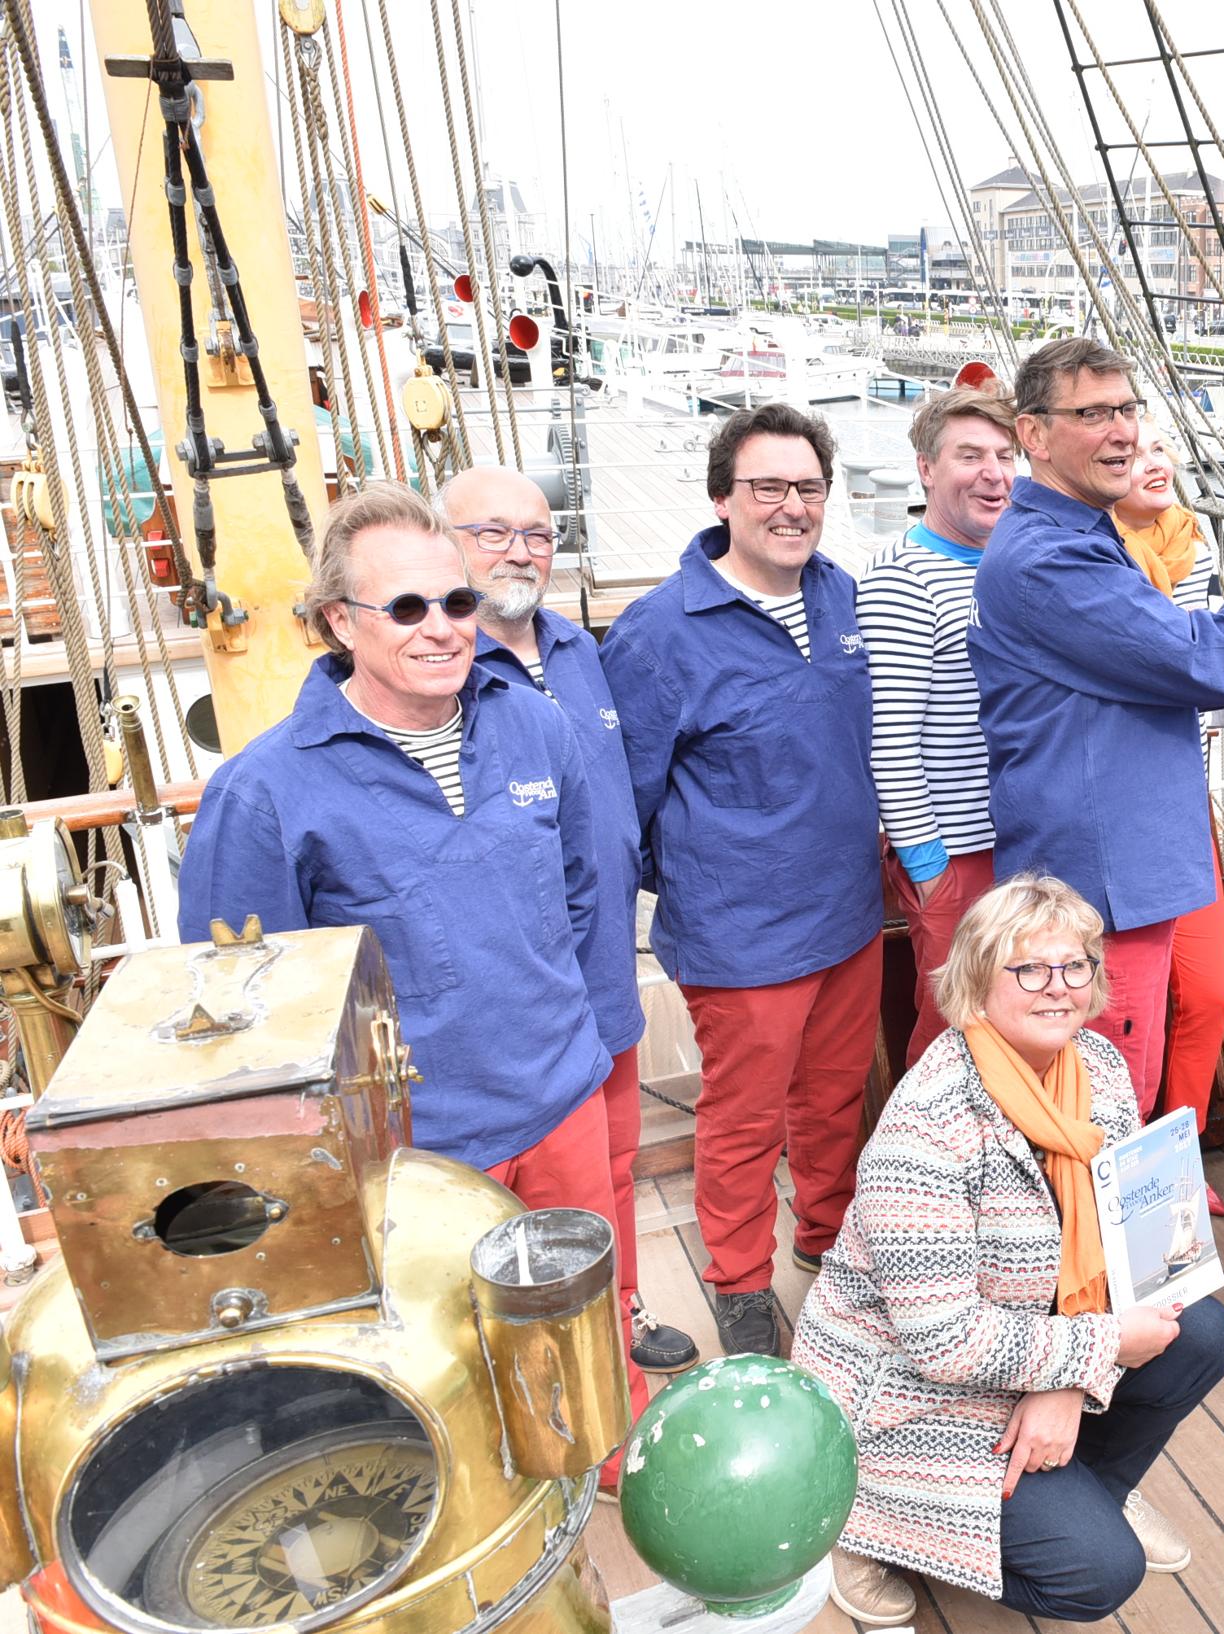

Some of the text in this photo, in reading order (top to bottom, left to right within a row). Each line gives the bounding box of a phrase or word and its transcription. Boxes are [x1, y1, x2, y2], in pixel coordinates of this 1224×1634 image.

[1178, 1129, 1191, 1141] MEI
[1108, 1176, 1160, 1213] Oostende
[1139, 1183, 1174, 1209] Anker
[324, 1483, 350, 1500] NE
[387, 1483, 411, 1500] E
